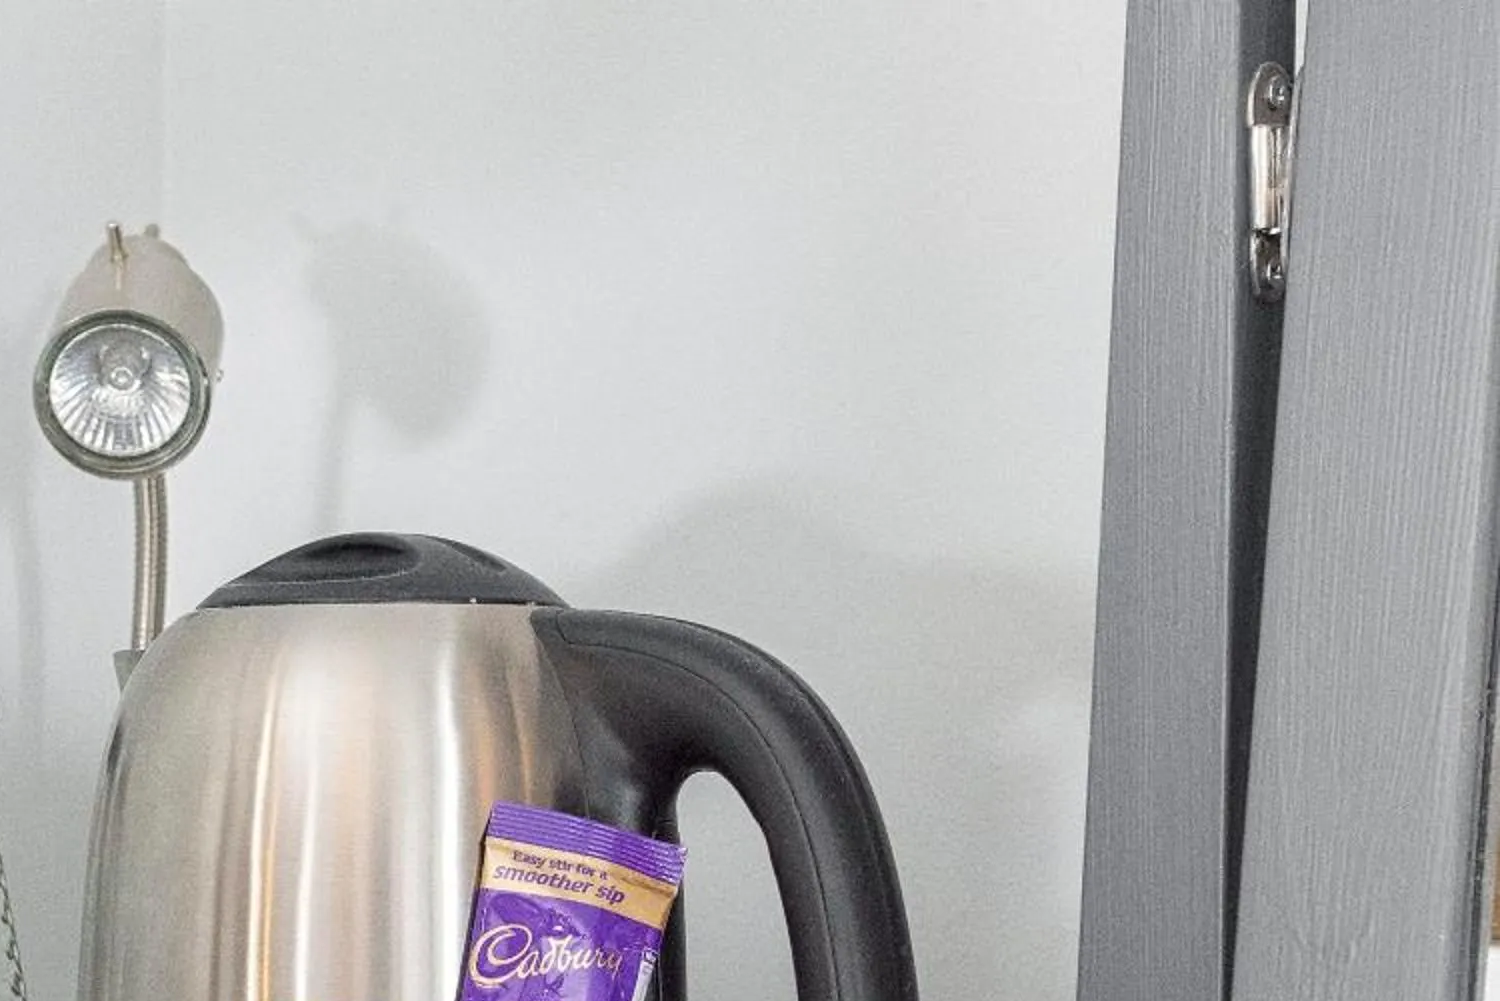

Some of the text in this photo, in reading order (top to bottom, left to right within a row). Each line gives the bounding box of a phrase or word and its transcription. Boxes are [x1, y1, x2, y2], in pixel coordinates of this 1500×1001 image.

[493, 864, 626, 905] smoother sip
[512, 850, 547, 869] Easy
[573, 862, 596, 878] for
[468, 923, 623, 989] Cadbury
